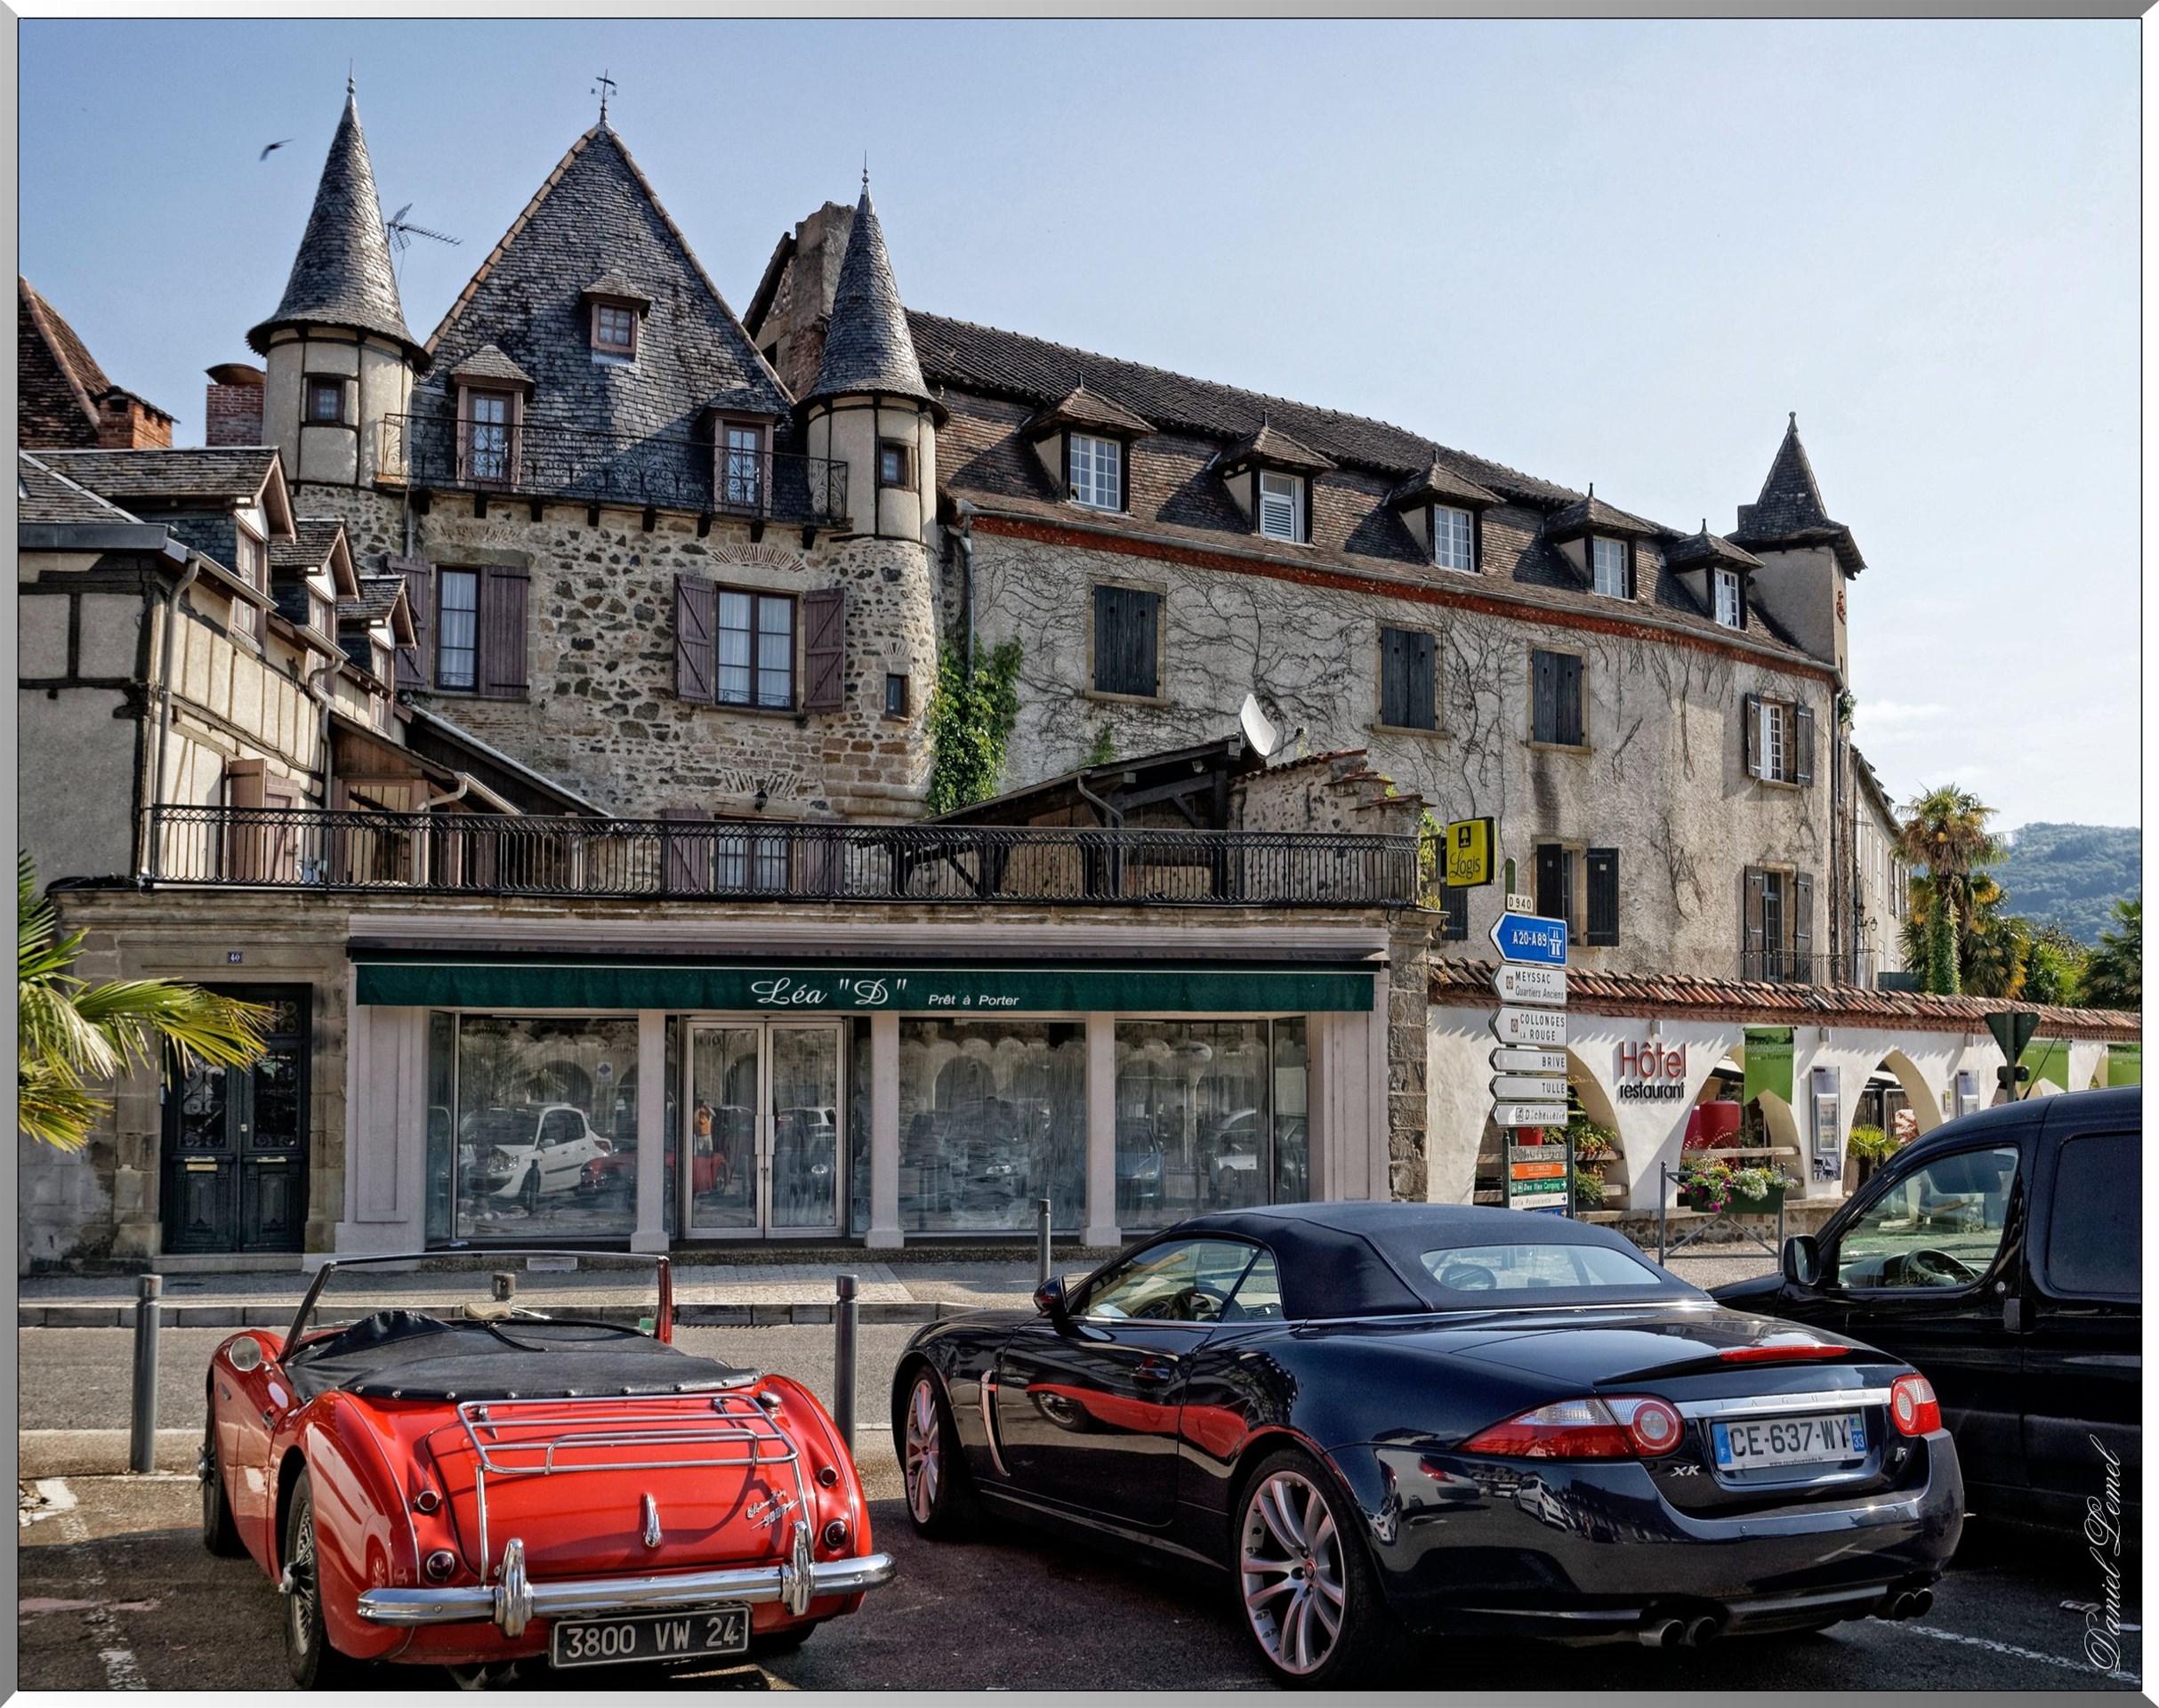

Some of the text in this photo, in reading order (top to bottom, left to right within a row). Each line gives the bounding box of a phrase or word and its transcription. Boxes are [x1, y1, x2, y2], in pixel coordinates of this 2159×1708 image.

[1448, 849, 1481, 879] Logis
[1509, 896, 1532, 909] D 940
[230, 953, 241, 962] 40
[1515, 971, 1551, 985] MEYSSAC
[751, 977, 827, 1005] Léa
[929, 994, 955, 1005] Prêt
[963, 995, 971, 1005] à
[979, 995, 1019, 1006] Porter
[1515, 987, 1564, 999] Quartiers Anciens
[1520, 1013, 1565, 1027] COLLONGES
[1530, 1029, 1556, 1041] ROUGE
[1542, 1057, 1566, 1068] BRIVE
[1618, 1042, 1687, 1078] Hôtel
[1542, 1083, 1566, 1094] TULLE
[1620, 1081, 1685, 1099] restaurant
[1720, 1447, 1726, 1458] F
[1853, 1434, 1865, 1448] 33
[1670, 1464, 1701, 1477] XK
[566, 1615, 739, 1658] 3800 VW 24
